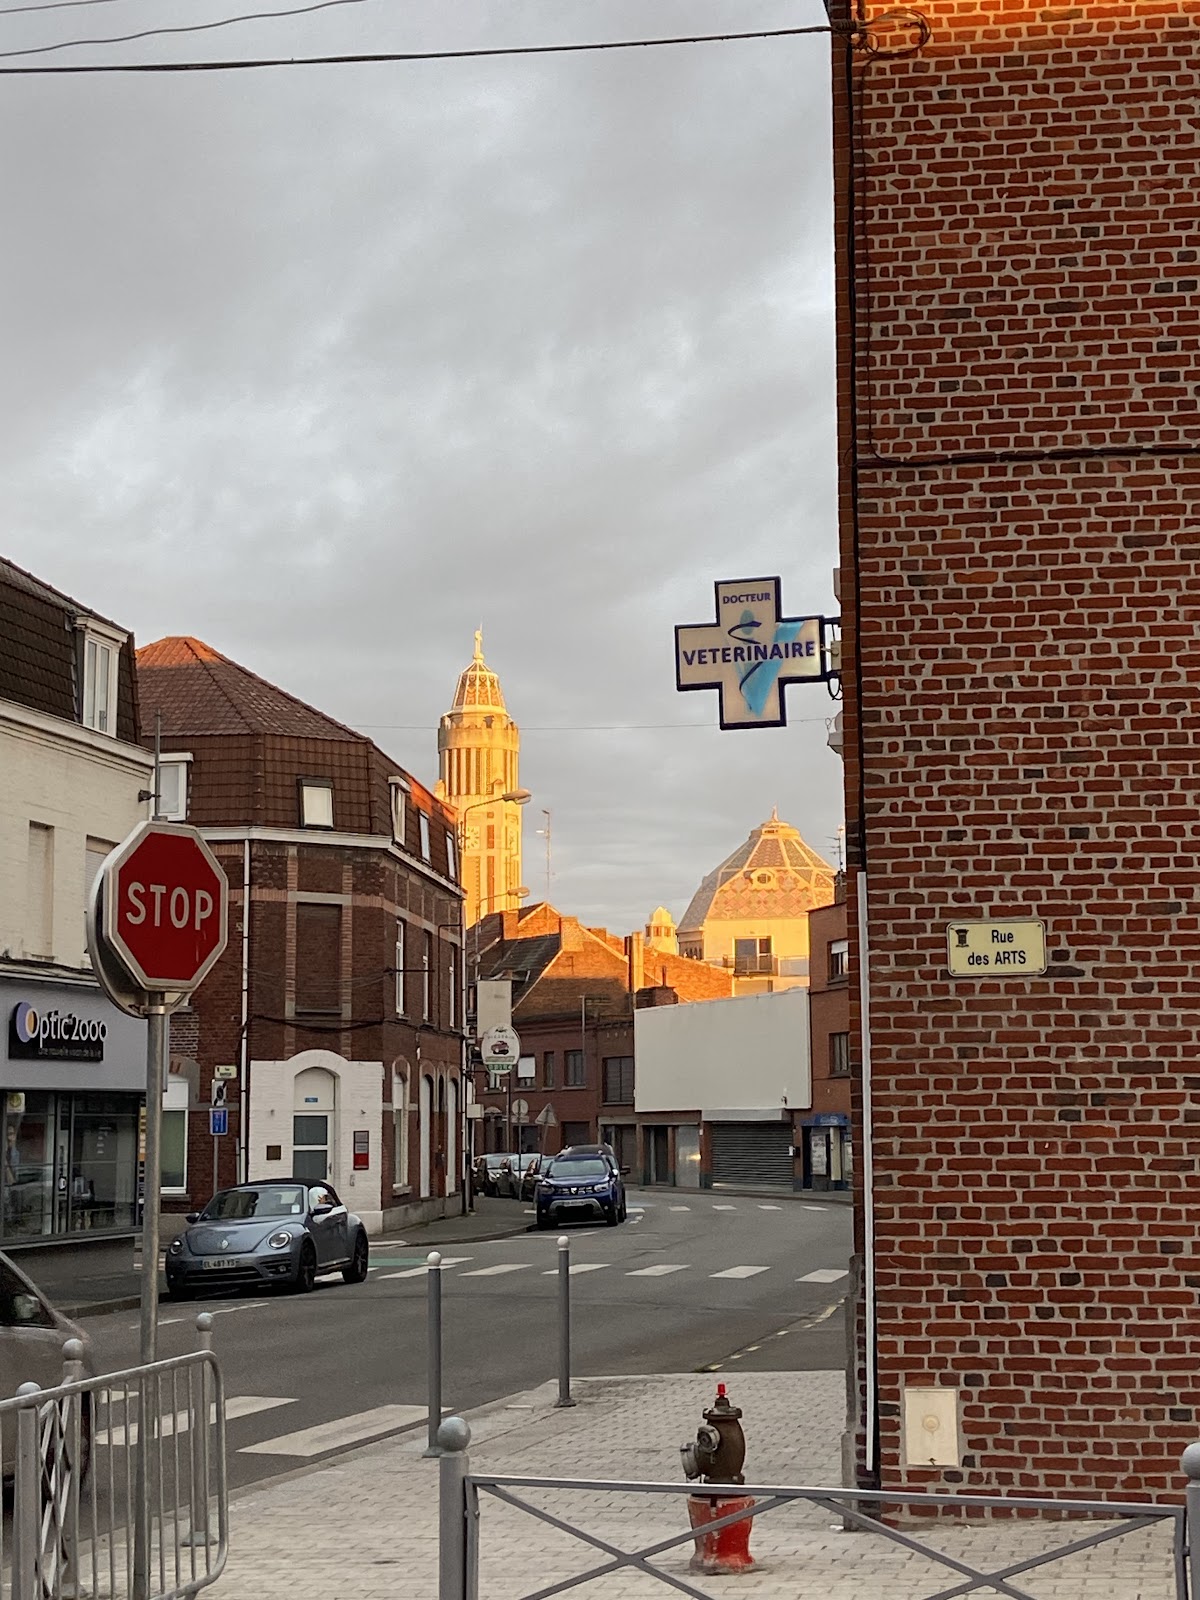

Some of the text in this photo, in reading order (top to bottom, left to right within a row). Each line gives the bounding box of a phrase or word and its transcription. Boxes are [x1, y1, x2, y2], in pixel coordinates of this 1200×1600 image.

[722, 592, 771, 605] DOCTEUR
[682, 641, 816, 666] VETERINAIRE
[125, 881, 213, 931] STOP
[991, 929, 1014, 943] Rue
[967, 950, 1026, 965] des ARTS
[25, 1007, 108, 1049] Optic 2000
